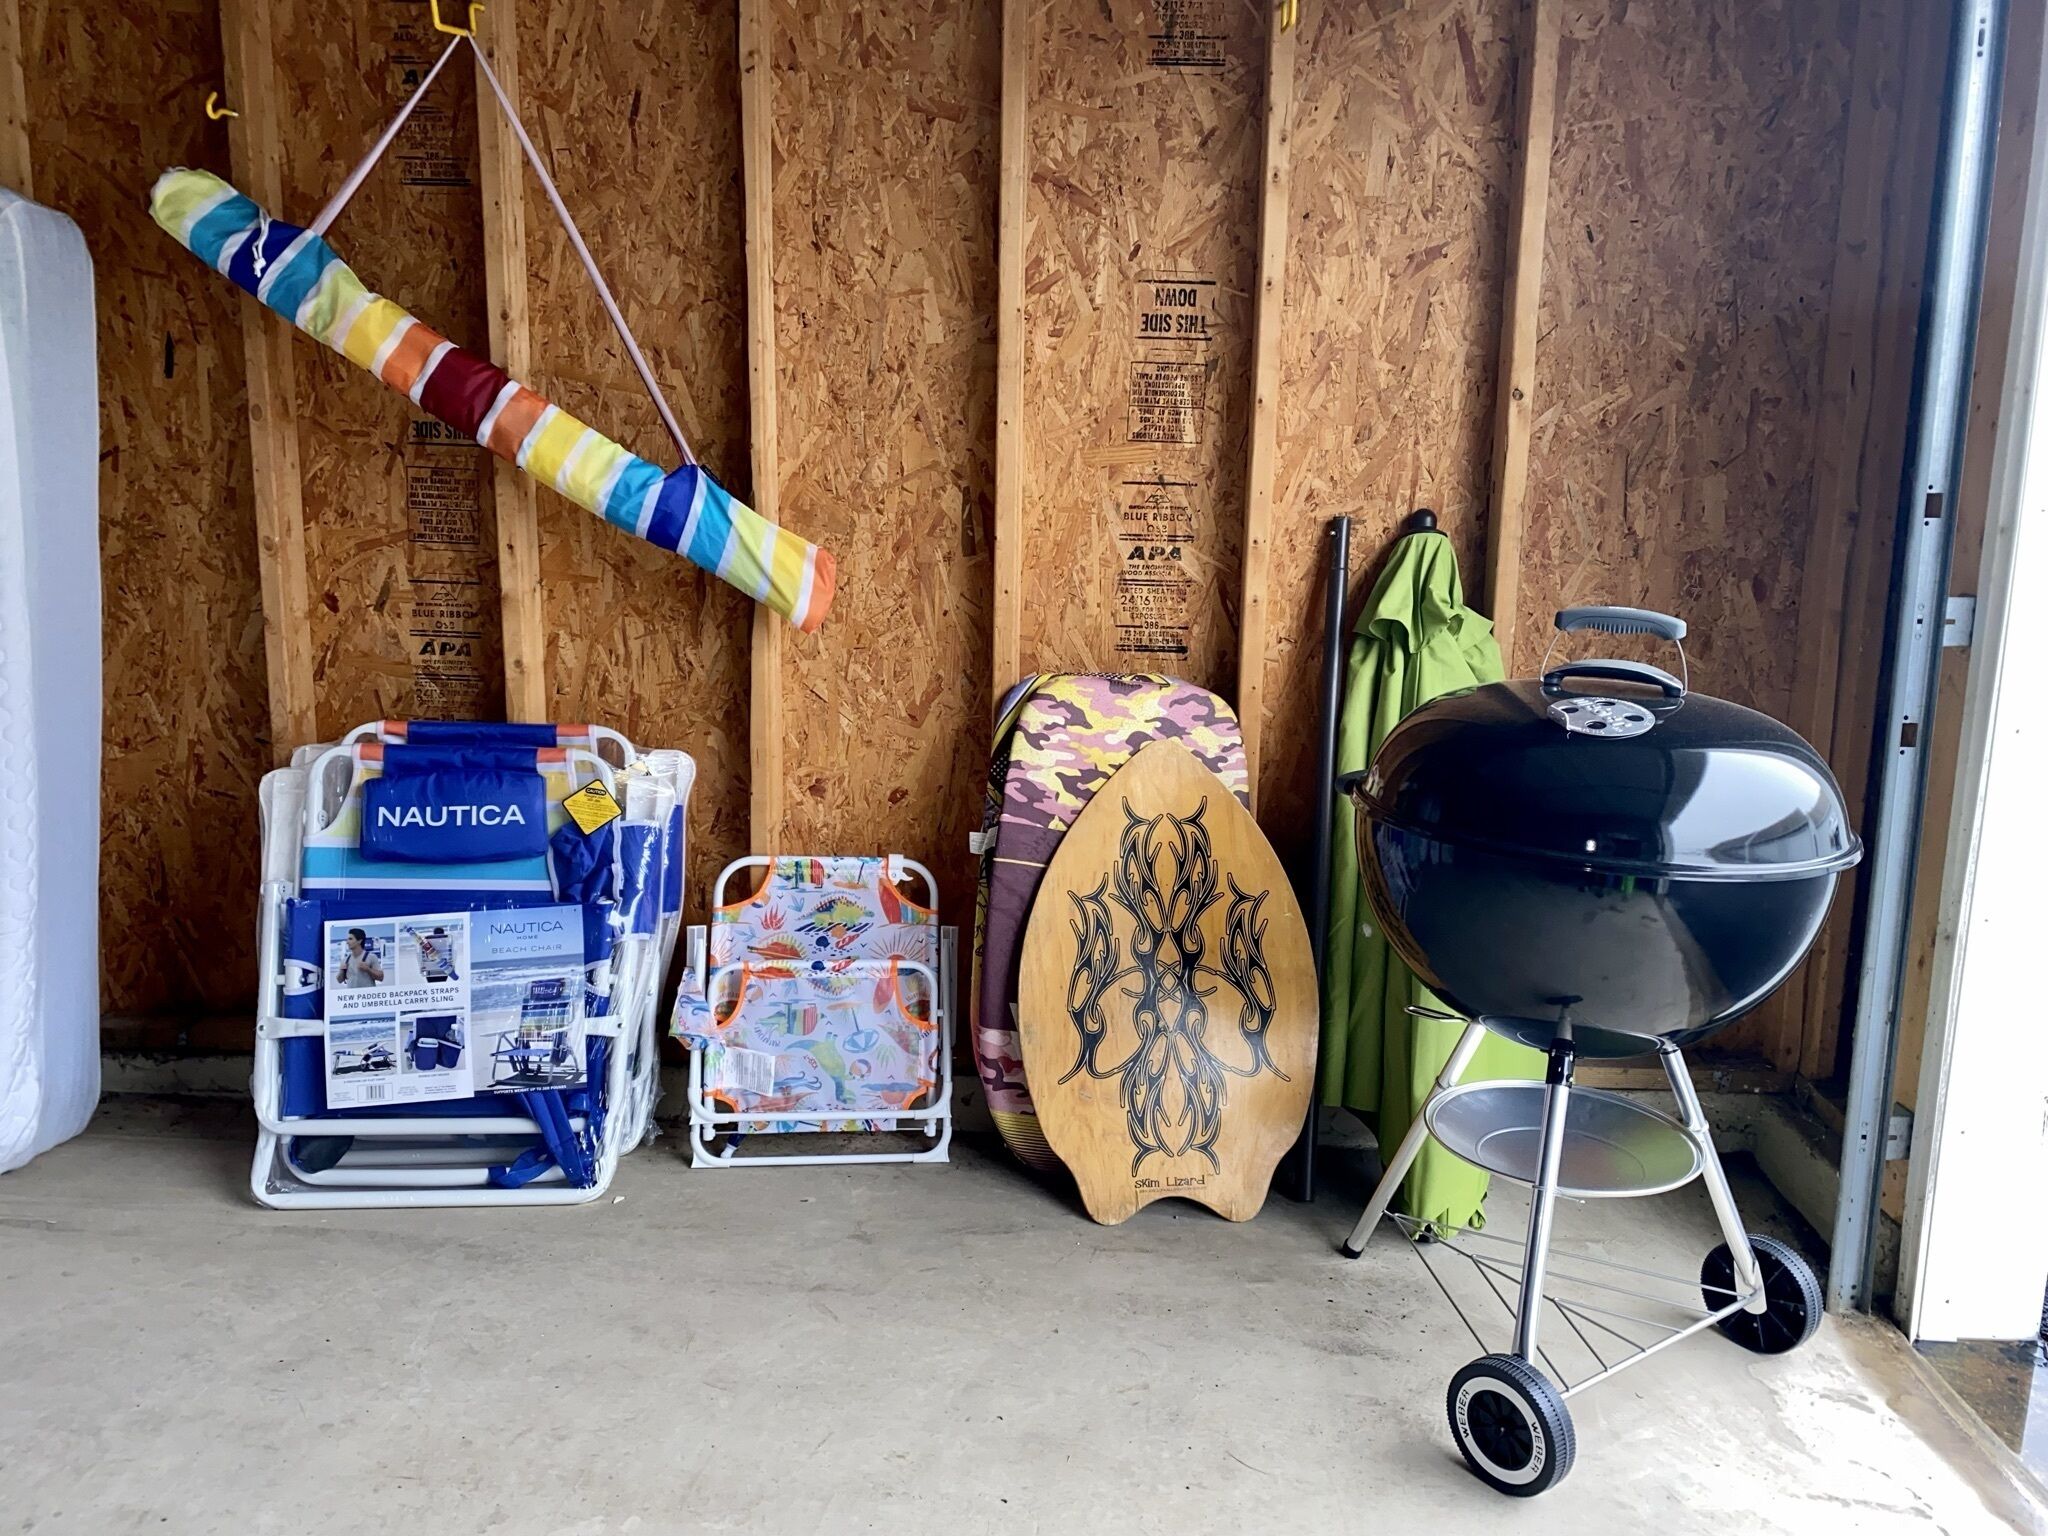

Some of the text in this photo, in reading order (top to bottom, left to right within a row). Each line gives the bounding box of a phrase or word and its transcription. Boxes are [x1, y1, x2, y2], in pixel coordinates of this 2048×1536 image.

[1155, 288, 1197, 307] DOWN
[1141, 313, 1207, 334] THIS SIDE
[412, 421, 441, 439] SIDE
[1123, 512, 1148, 521] BLUE
[1127, 545, 1182, 561] APA
[412, 608, 435, 617] BLUE
[419, 641, 472, 657] APA
[377, 804, 526, 827] NAUTICA
[490, 921, 563, 934] NAUTICA
[491, 944, 562, 954] BEACH CHAIR
[357, 992, 387, 1000] PADDED
[389, 989, 428, 998] BACKPACK
[431, 987, 459, 995] STRAPS
[361, 999, 402, 1008] UMBRELLA
[405, 997, 428, 1005] CARRY
[431, 995, 454, 1003] SLING
[1458, 1389, 1470, 1439] WEBER
[1531, 1421, 1543, 1474] WEBER
